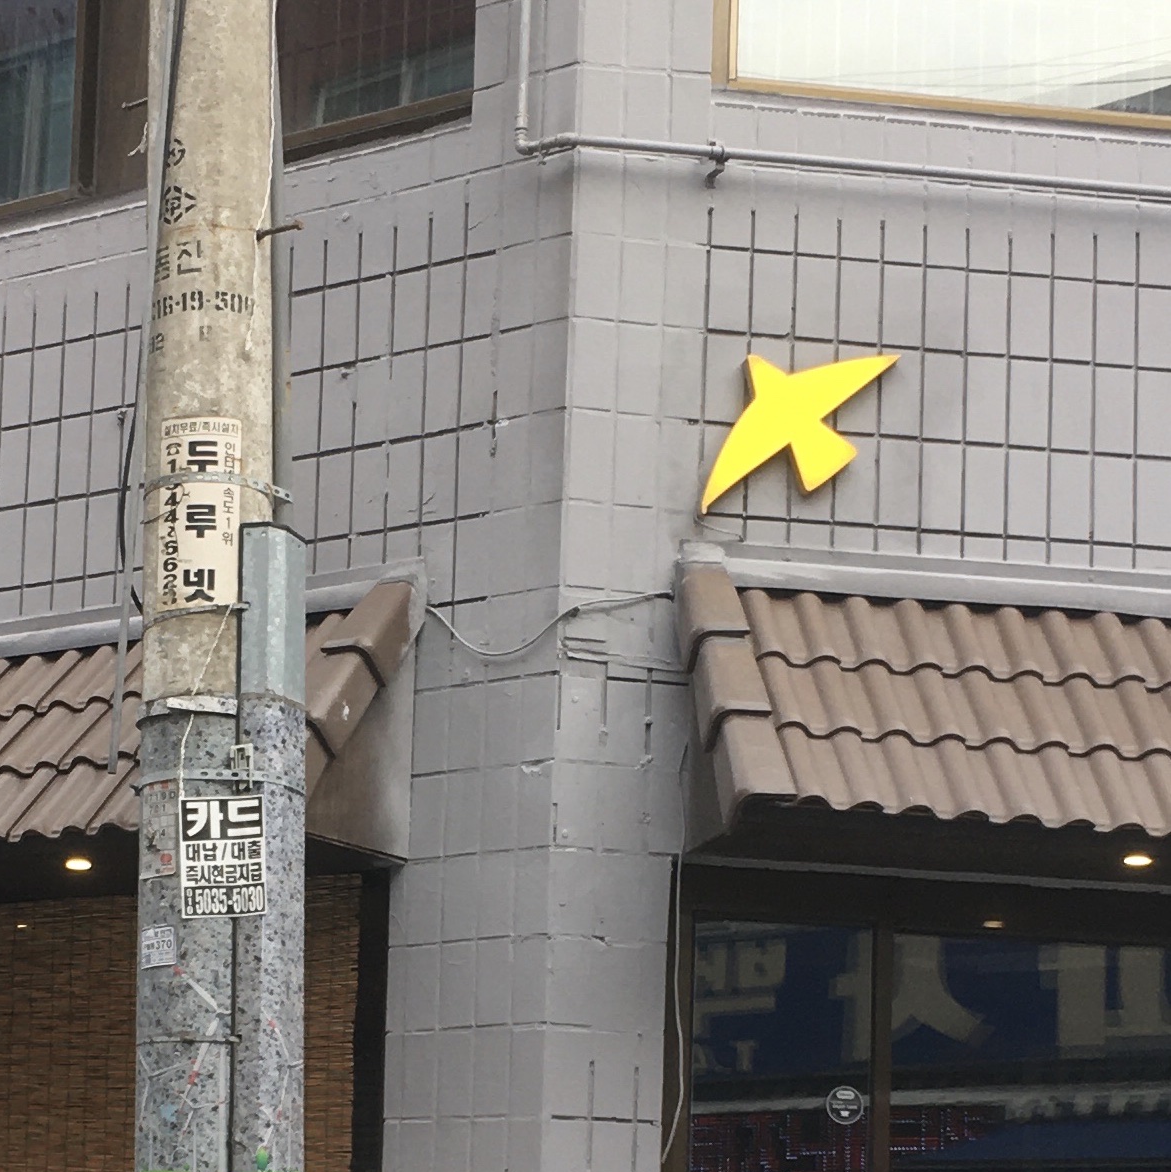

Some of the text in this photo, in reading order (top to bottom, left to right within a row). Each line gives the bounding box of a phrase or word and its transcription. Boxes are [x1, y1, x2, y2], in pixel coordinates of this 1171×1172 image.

[186, 799, 261, 839] 카드
[186, 862, 262, 885] 즉시현금지급
[195, 885, 264, 915] 5035-5030
